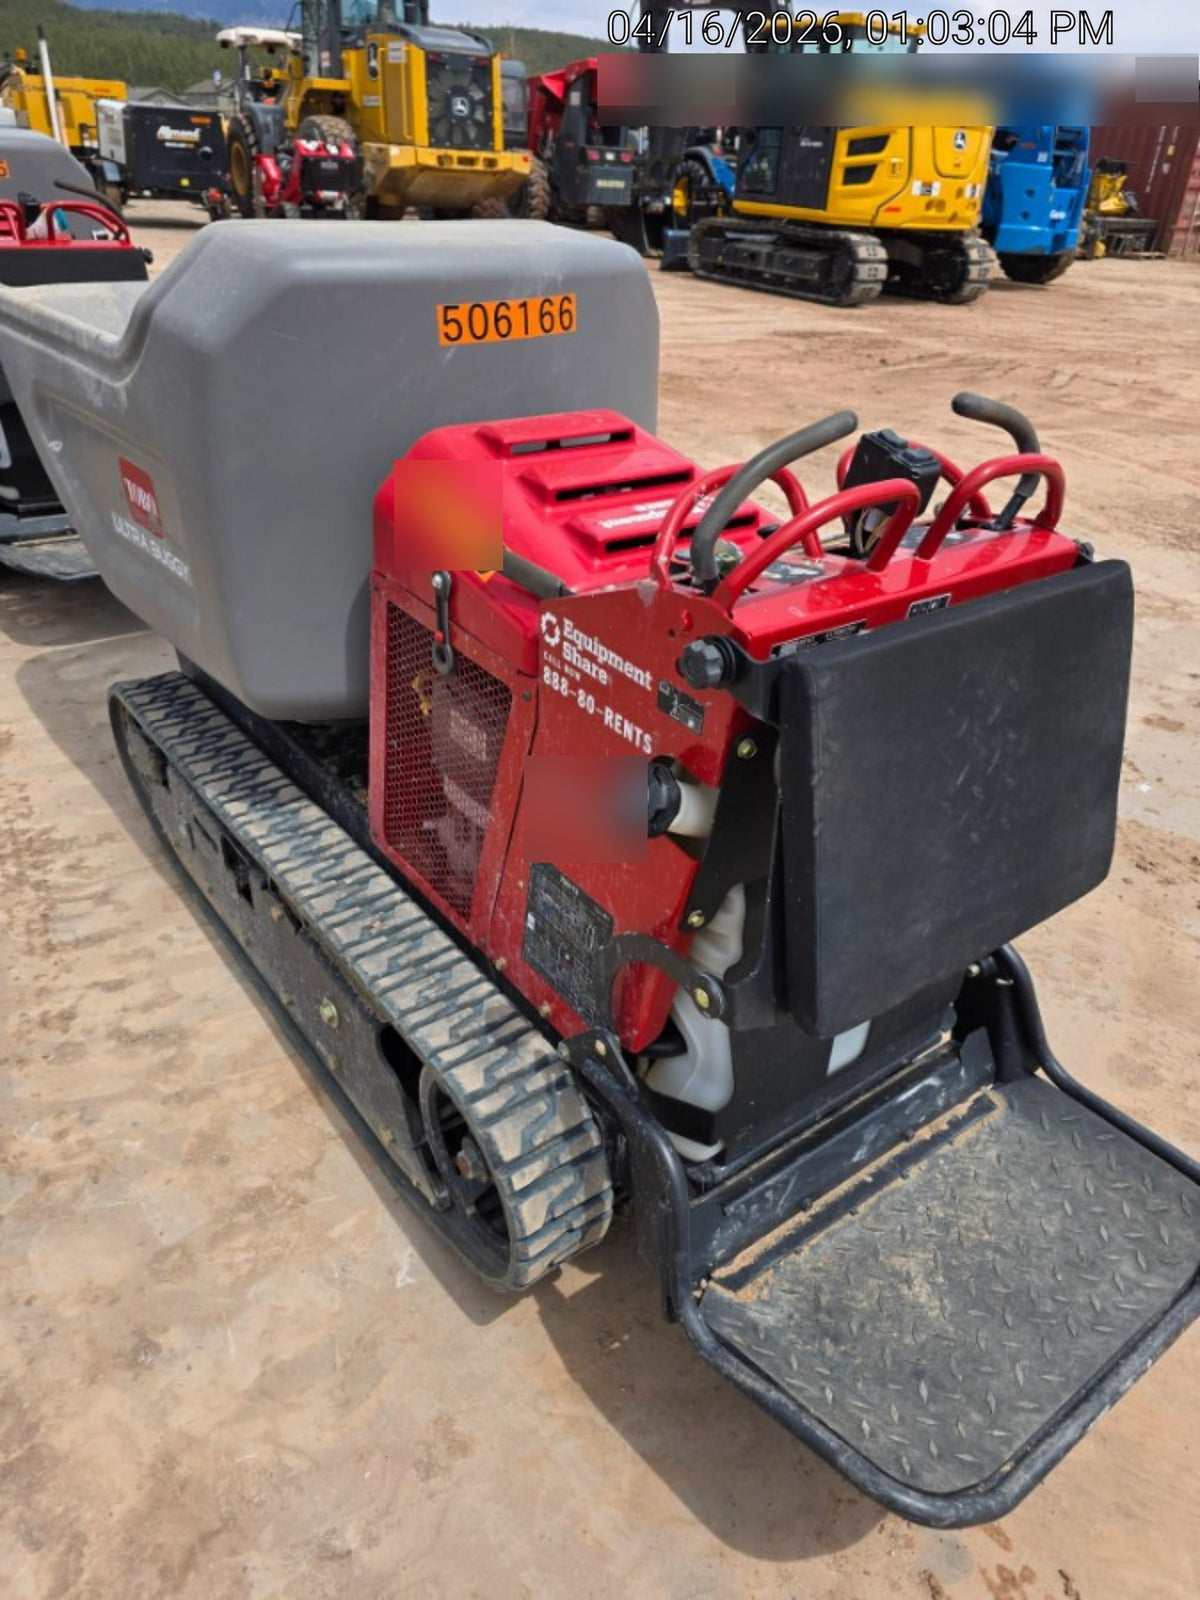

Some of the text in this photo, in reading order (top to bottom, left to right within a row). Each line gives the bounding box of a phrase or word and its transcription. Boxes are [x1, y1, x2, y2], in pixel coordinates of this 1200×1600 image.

[442, 296, 573, 342] 506166
[561, 641, 608, 686] Share
[562, 616, 653, 692] Equipment
[543, 665, 654, 755] 888-80-RENTS
